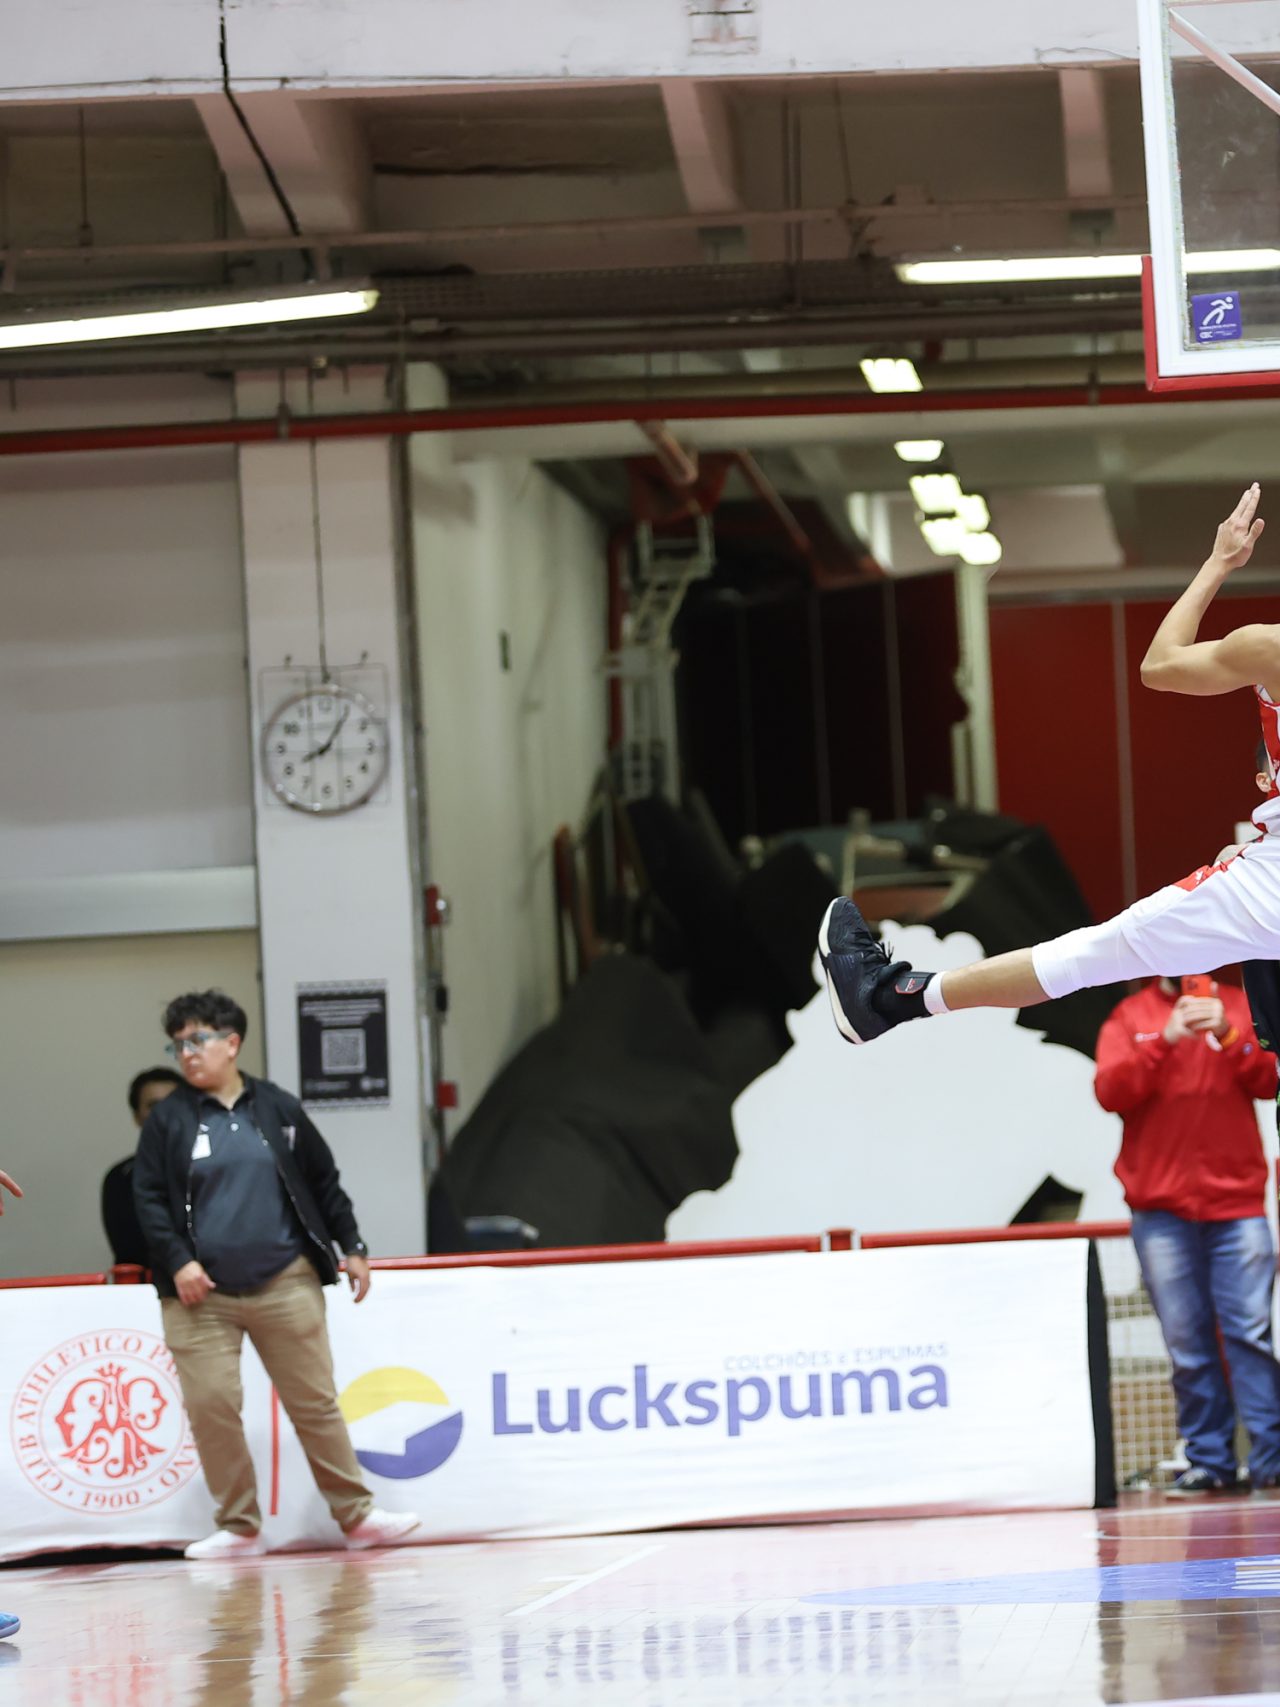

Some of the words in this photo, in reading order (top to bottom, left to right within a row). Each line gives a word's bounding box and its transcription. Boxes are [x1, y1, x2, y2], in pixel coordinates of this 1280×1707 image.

[17, 1335, 143, 1425] ATHLETICO
[492, 1363, 949, 1437] Luckspuma
[18, 1433, 64, 1492] CLUB
[82, 1490, 141, 1509] 1900
